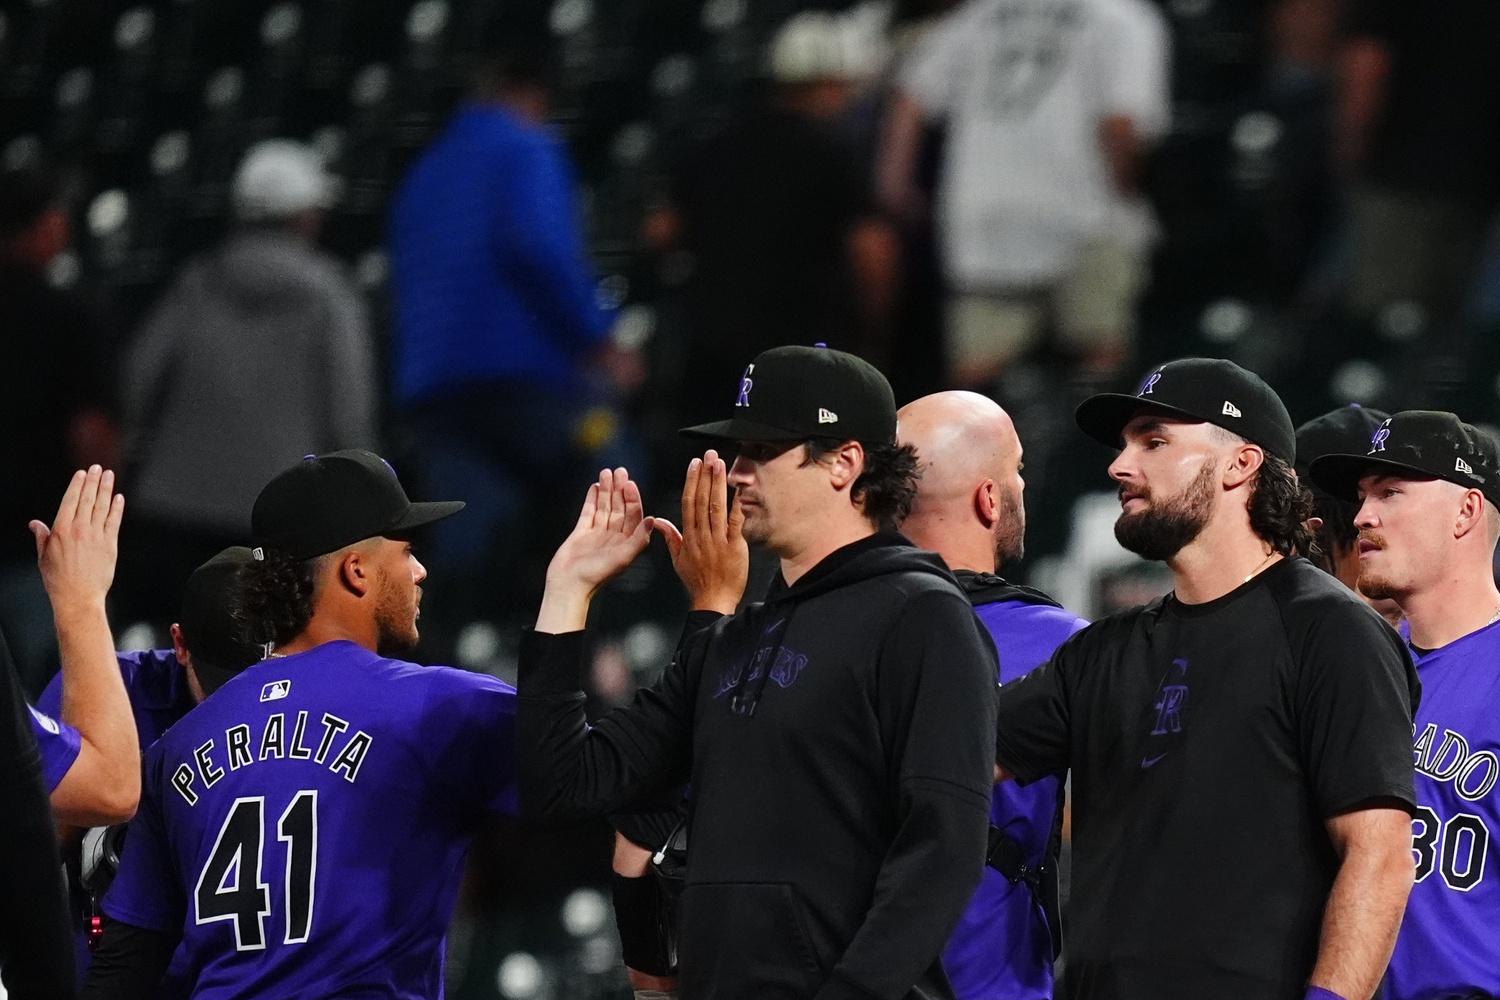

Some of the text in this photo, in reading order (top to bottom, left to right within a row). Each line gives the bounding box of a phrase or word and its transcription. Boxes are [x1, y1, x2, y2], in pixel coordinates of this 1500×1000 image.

[171, 710, 373, 807] PERALTA
[1412, 722, 1499, 802] ADO
[194, 789, 319, 952] 41
[1412, 805, 1489, 893] 30
